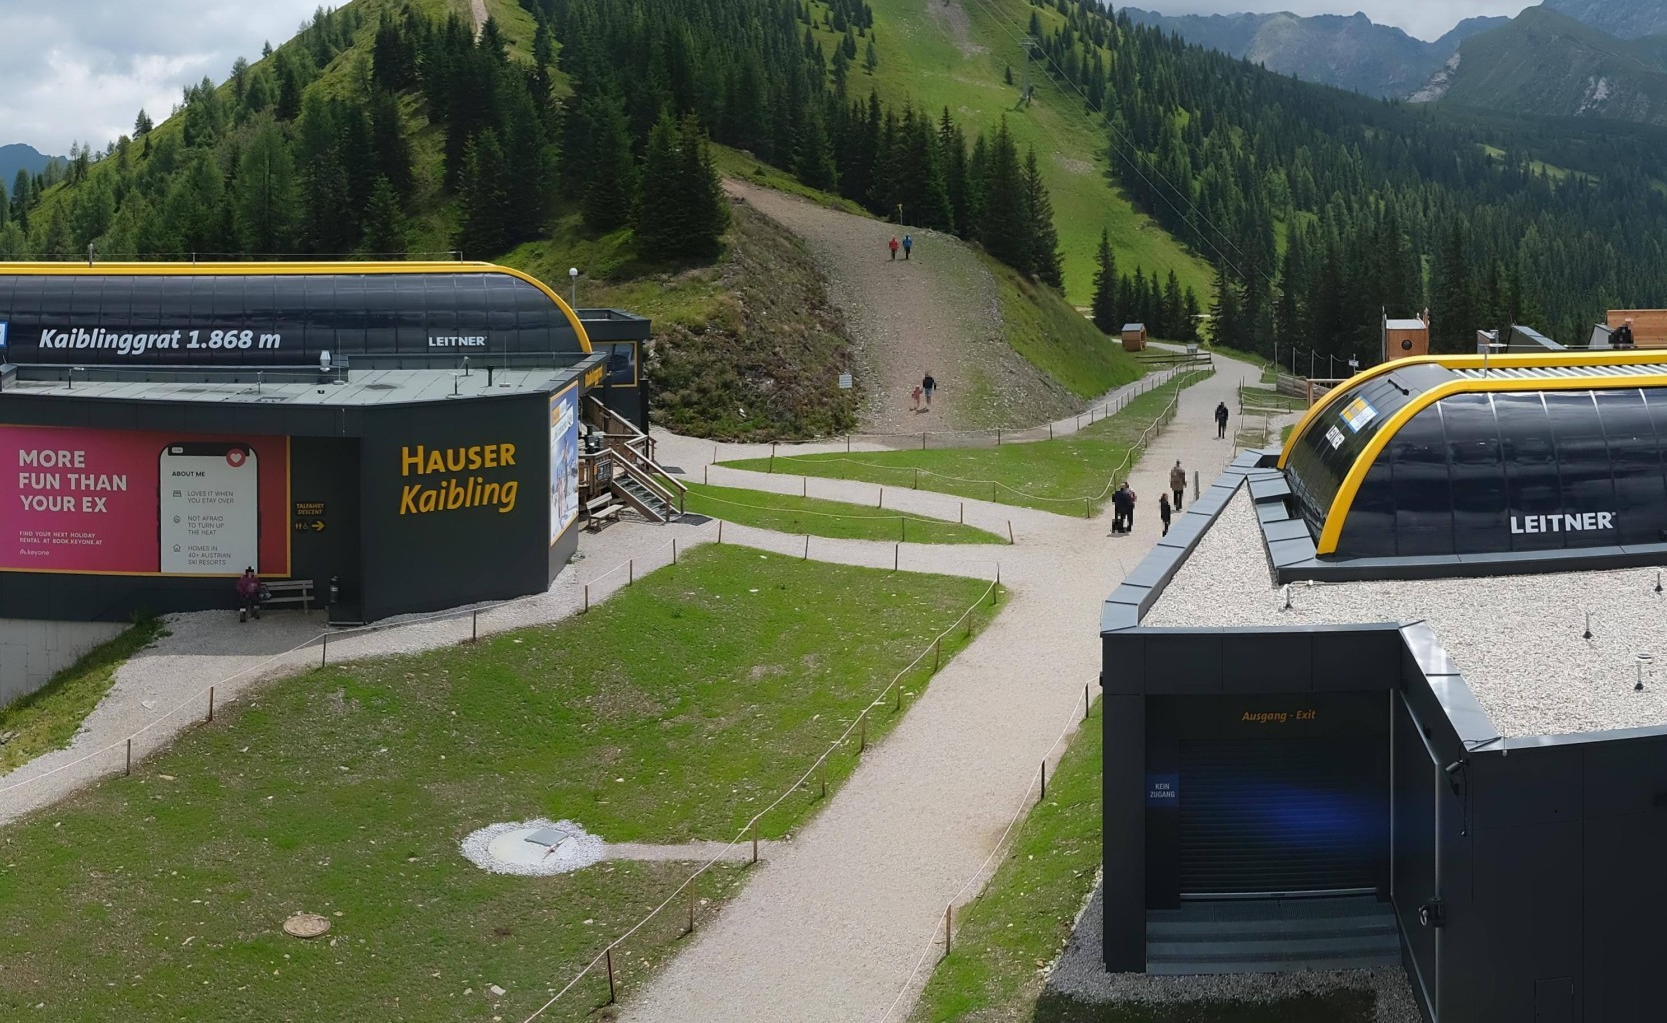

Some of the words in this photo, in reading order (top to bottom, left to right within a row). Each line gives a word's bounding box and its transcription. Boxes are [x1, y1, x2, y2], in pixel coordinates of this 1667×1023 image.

[39, 328, 181, 355] Kaiblinggrat
[187, 329, 252, 349] 1.868
[258, 333, 281, 349] m
[428, 336, 486, 346] LEITNER
[19, 449, 85, 468] MORE
[402, 443, 516, 476] HAUSER
[19, 472, 60, 490] FUN
[67, 473, 127, 491] THAN
[20, 495, 75, 512] YOUR
[82, 496, 107, 513] EX
[400, 477, 518, 515] Kaibling
[1241, 710, 1287, 723] Ausgang
[1296, 709, 1317, 720] Exit
